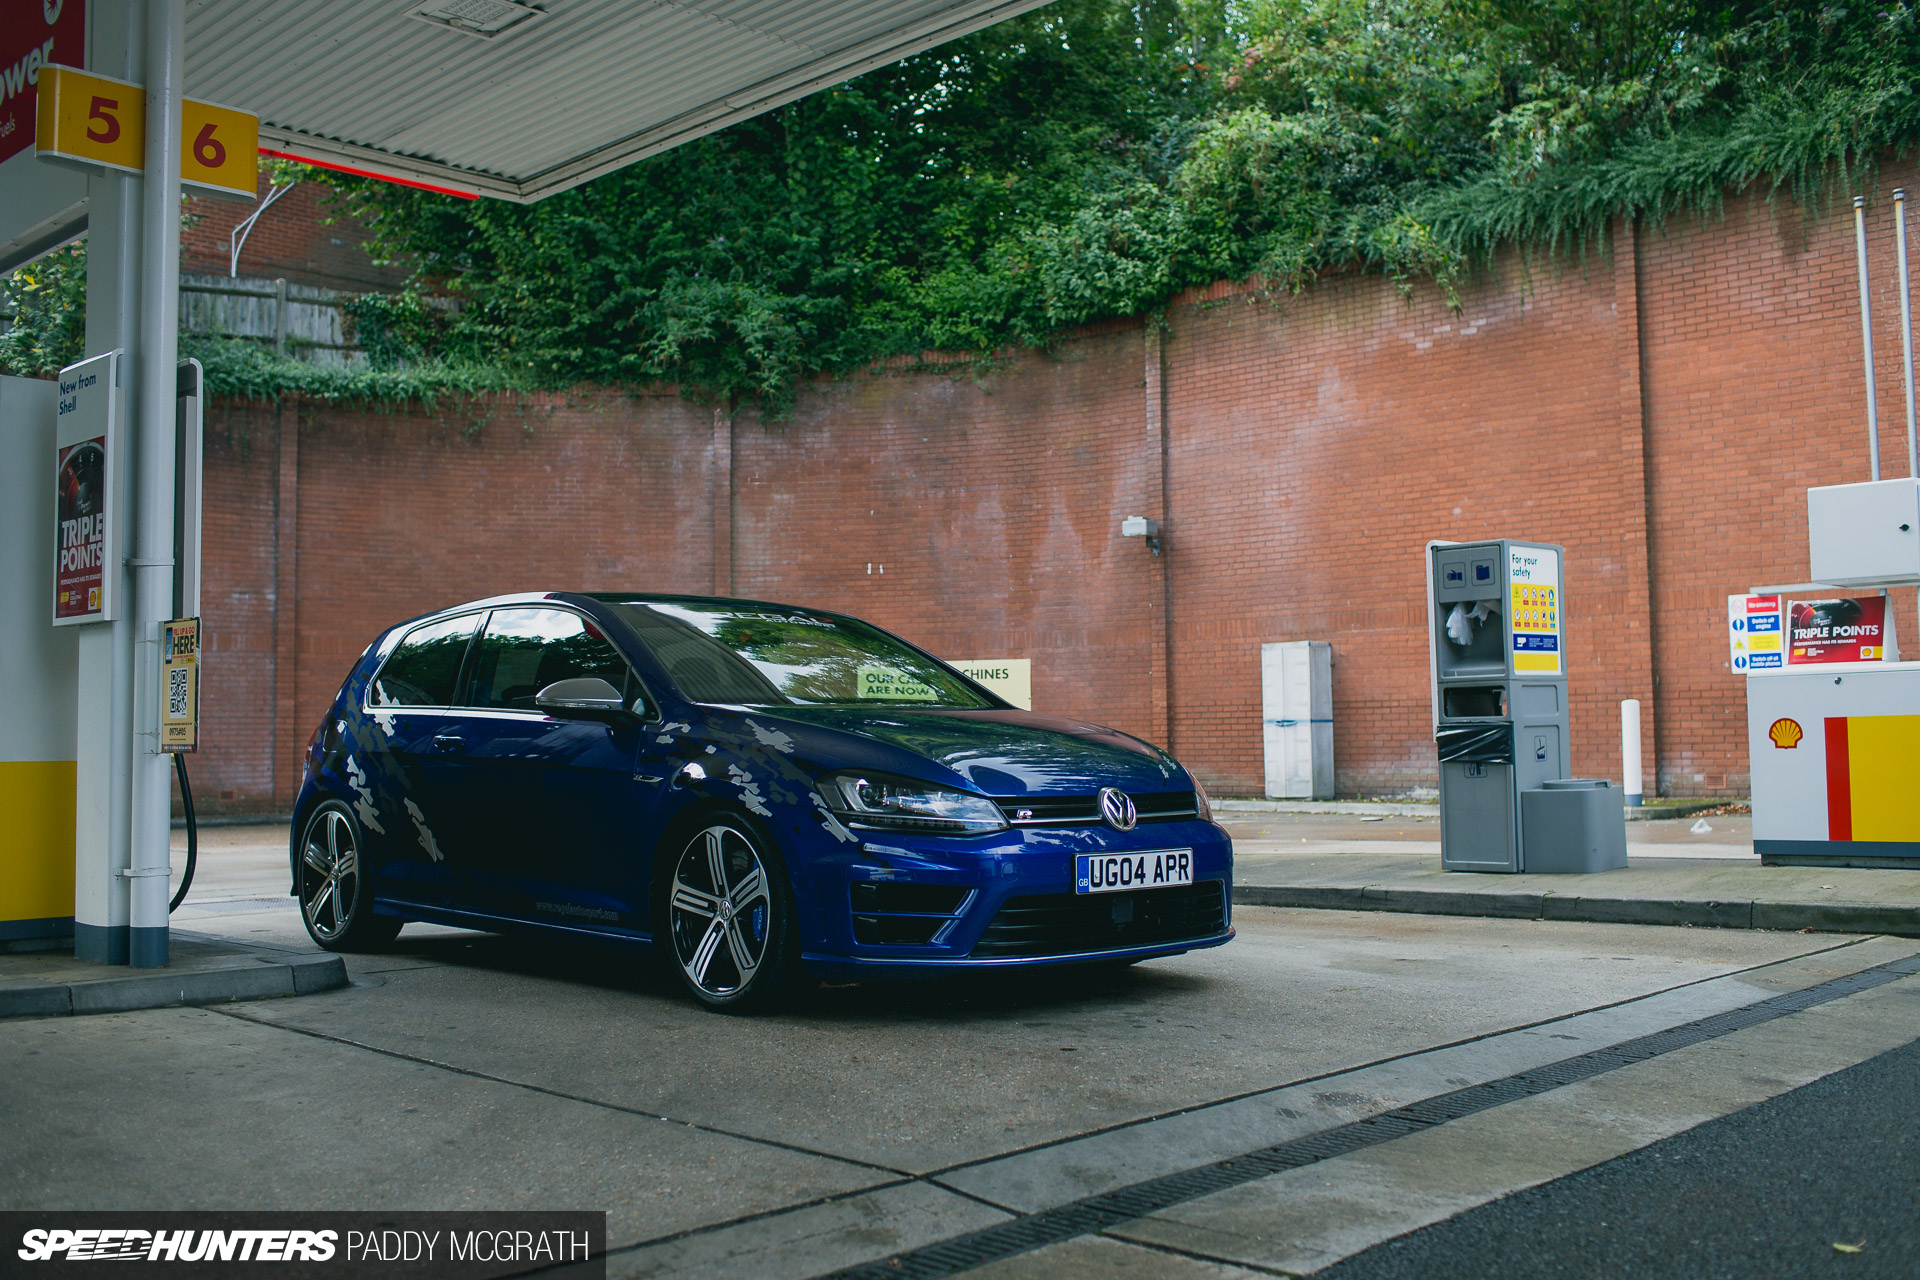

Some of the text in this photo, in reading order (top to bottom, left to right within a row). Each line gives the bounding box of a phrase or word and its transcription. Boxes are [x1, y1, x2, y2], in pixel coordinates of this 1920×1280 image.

[0, 112, 15, 138] uels
[86, 95, 121, 144] 5
[193, 123, 226, 168] 6
[60, 374, 96, 396] New from
[59, 395, 76, 415] Shell
[62, 513, 103, 548] TRIPLE
[60, 541, 103, 573] POINTS
[1512, 554, 1538, 566] For your
[1512, 567, 1531, 579] safety
[1794, 625, 1879, 639] TRIPLE POINTS
[173, 634, 195, 655] HERE
[866, 673, 894, 683] OUR
[866, 686, 930, 695] ARE NOW
[1016, 809, 1033, 819] R
[1079, 878, 1089, 887] GB
[1153, 853, 1190, 883] APR
